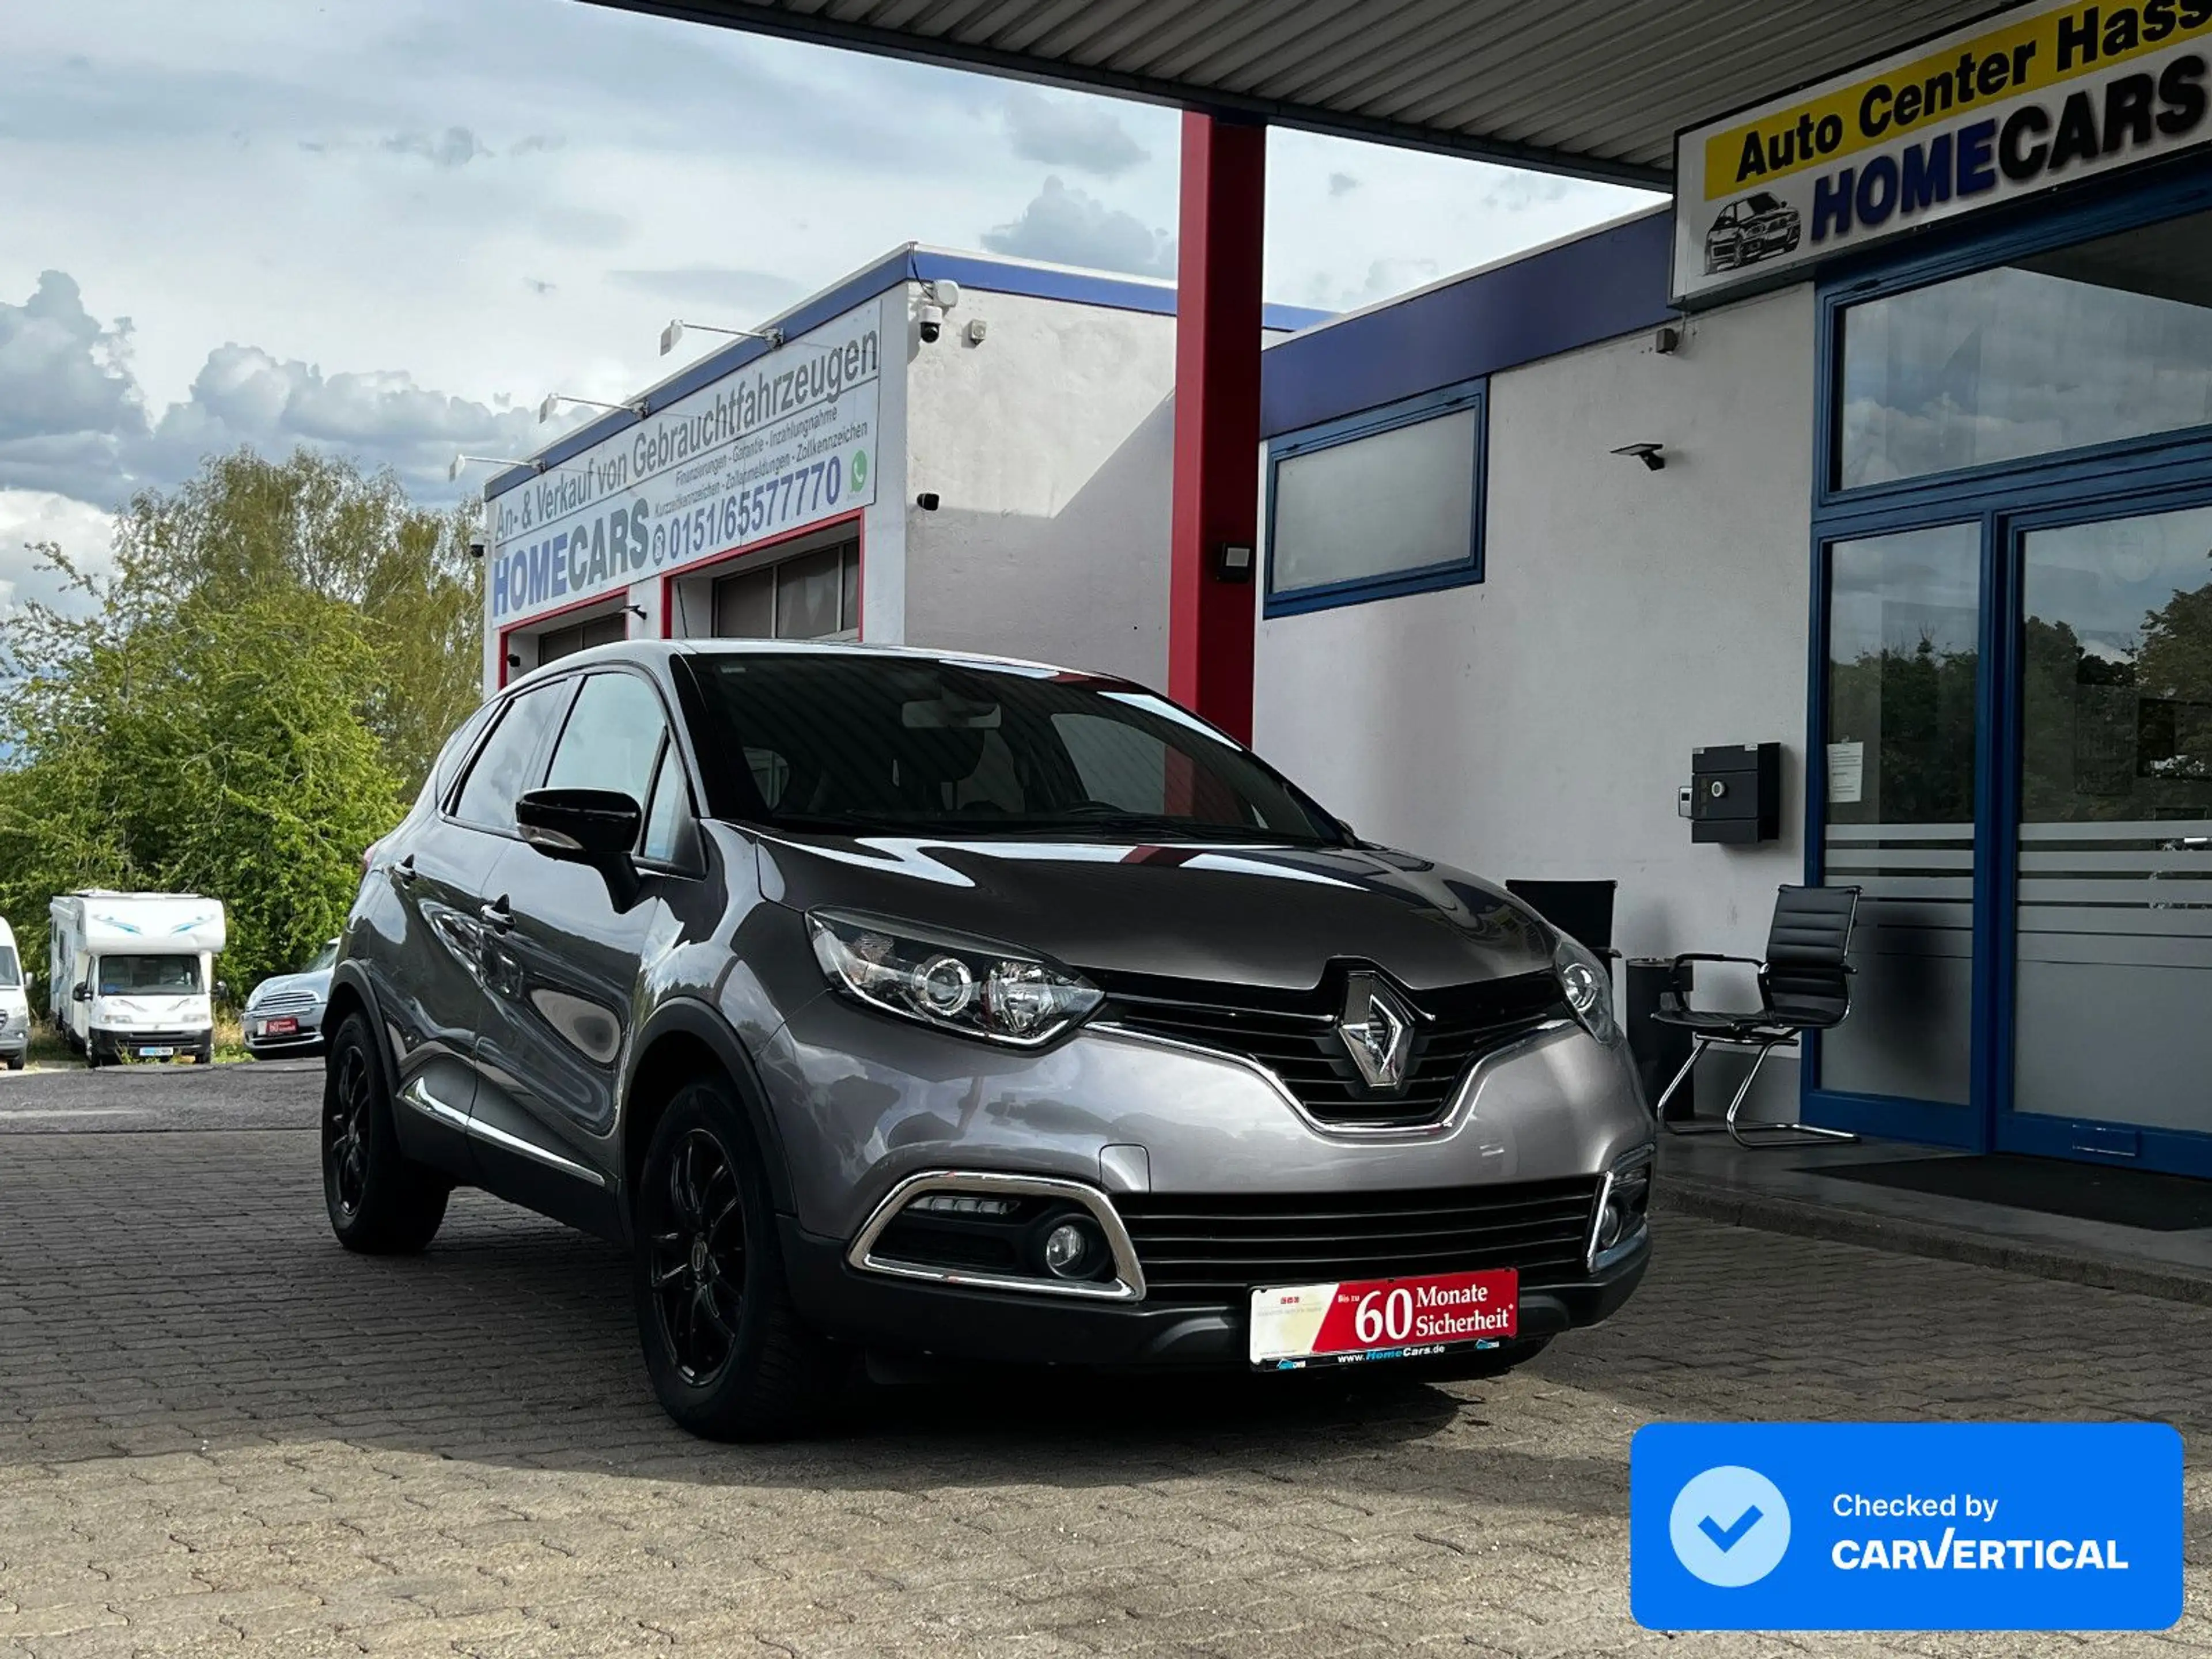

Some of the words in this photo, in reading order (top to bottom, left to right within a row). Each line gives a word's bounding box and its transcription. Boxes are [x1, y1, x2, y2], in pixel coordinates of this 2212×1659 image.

[1735, 113, 1843, 183] Auto
[1858, 39, 2037, 138] Center
[1810, 54, 2207, 242] HOMECARS
[522, 491, 532, 529] &
[536, 457, 594, 521] Verkauf
[597, 453, 627, 494] von
[634, 329, 877, 478] Gebrauchtfahrzeugen
[493, 497, 649, 618] HOMECARS
[669, 456, 841, 560] 0151/65577770
[1355, 1288, 1413, 1343] 60
[1415, 1283, 1488, 1308] Monate
